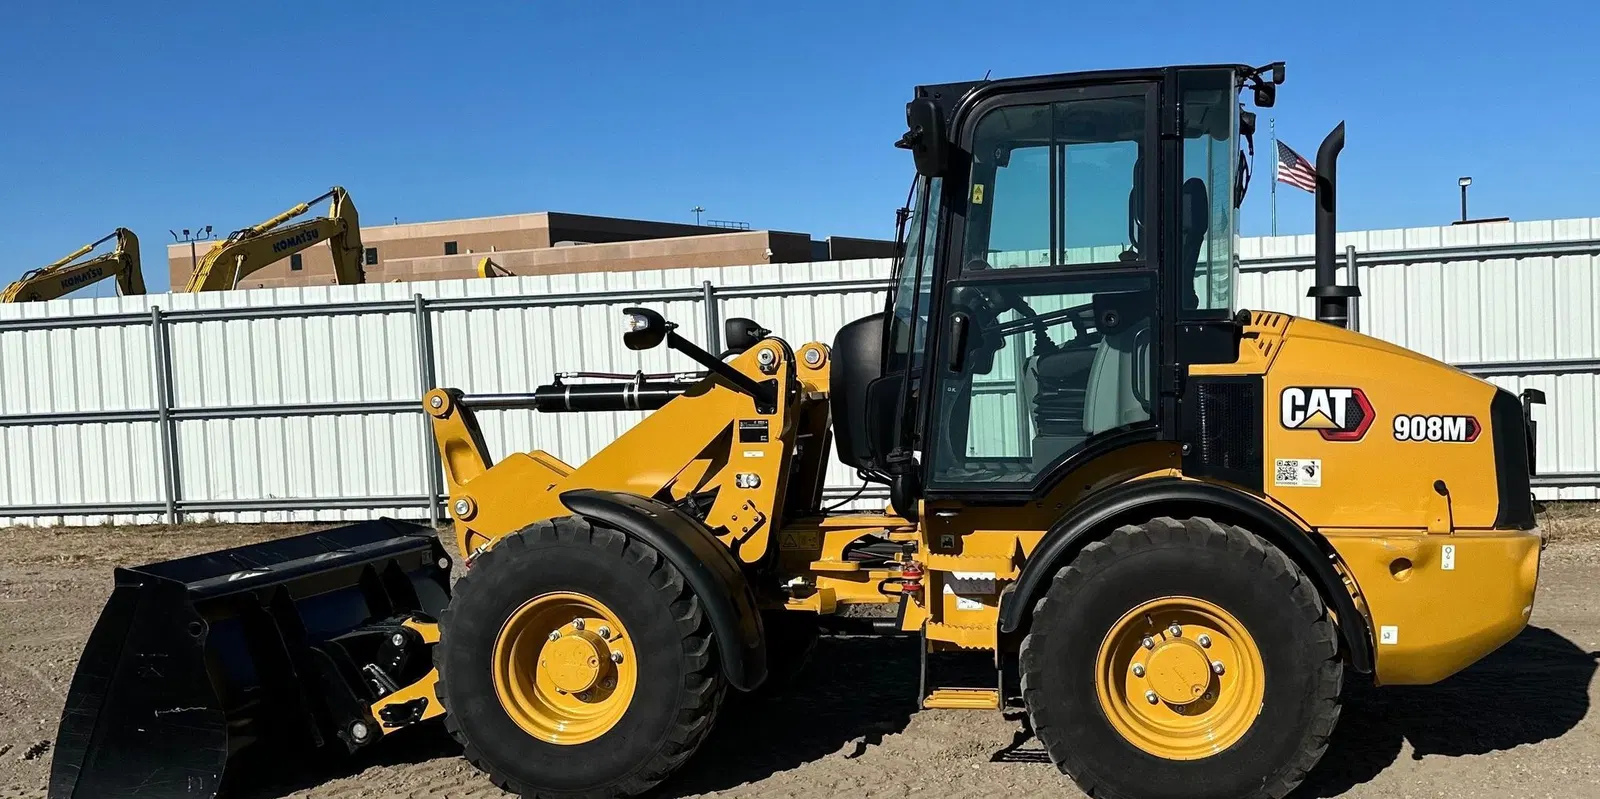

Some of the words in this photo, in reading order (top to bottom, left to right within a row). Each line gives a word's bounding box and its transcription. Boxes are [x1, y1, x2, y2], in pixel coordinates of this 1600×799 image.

[272, 229, 319, 252] KOMATSU
[60, 267, 103, 289] KOMATSU
[1282, 387, 1352, 428] CAT
[1394, 416, 1466, 441] 908M
